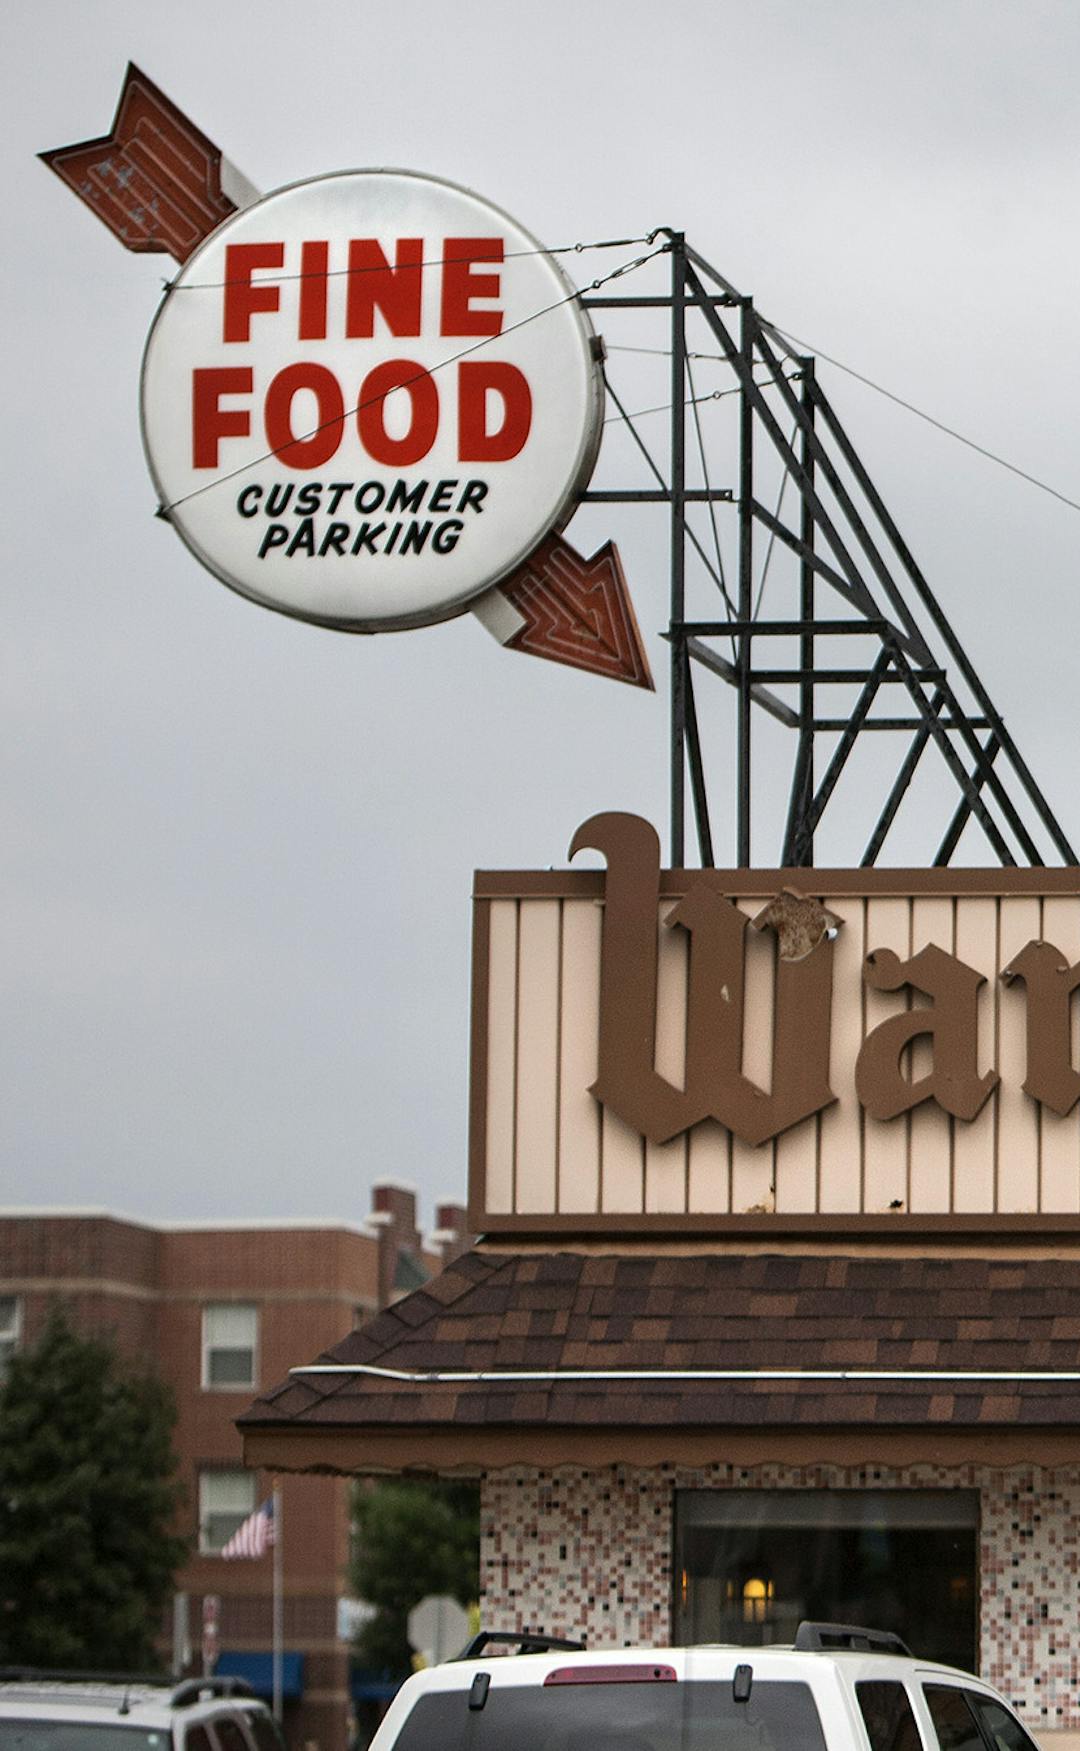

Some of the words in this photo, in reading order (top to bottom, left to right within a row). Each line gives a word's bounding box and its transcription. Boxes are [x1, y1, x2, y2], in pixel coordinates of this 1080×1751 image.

[222, 237, 505, 343] FINE
[192, 359, 533, 470] FOOD
[236, 479, 490, 519] CUSTOMER
[257, 517, 465, 559] PARKING
